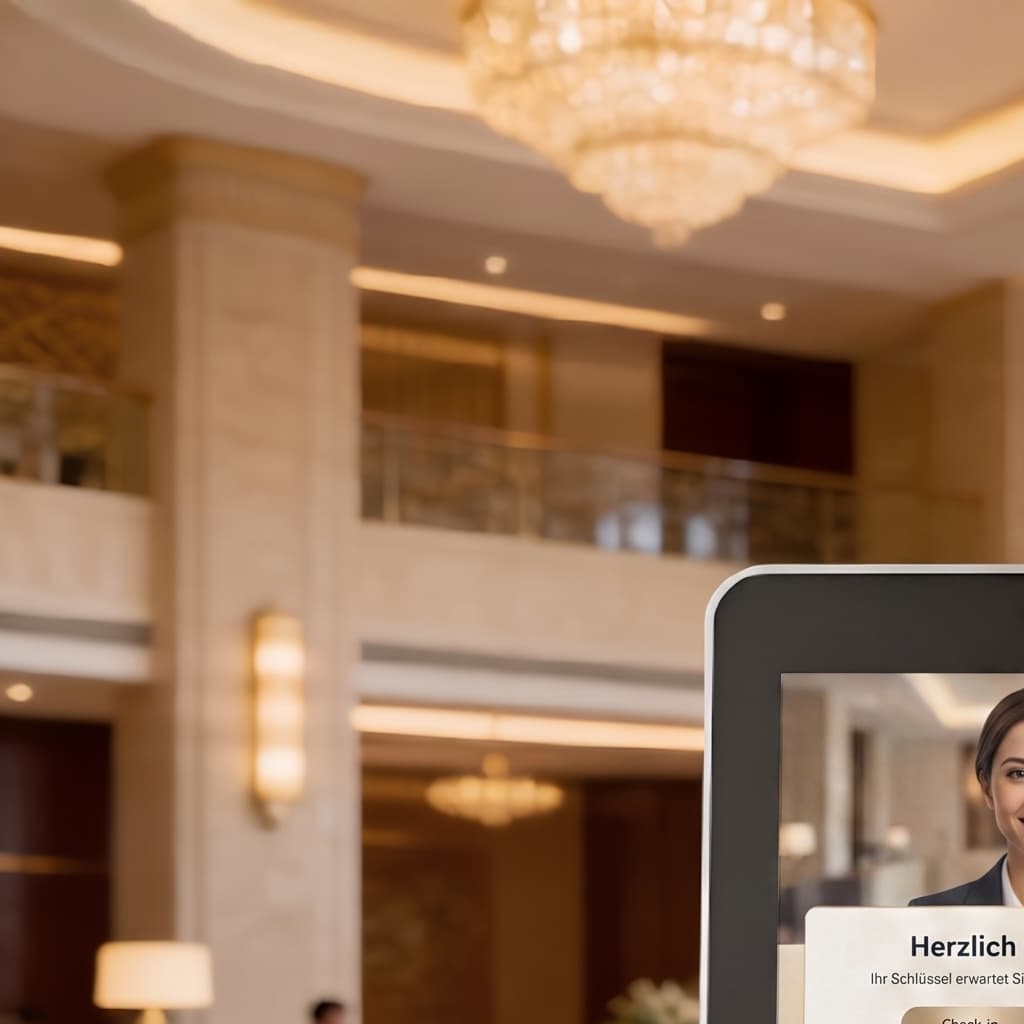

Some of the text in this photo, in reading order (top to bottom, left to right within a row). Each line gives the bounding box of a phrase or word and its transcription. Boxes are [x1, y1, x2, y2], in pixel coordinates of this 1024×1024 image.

[911, 934, 1016, 958] Herzlich
[870, 972, 888, 985] Ihr
[890, 972, 952, 985] Schlüssel
[955, 973, 1009, 985] erwartet
